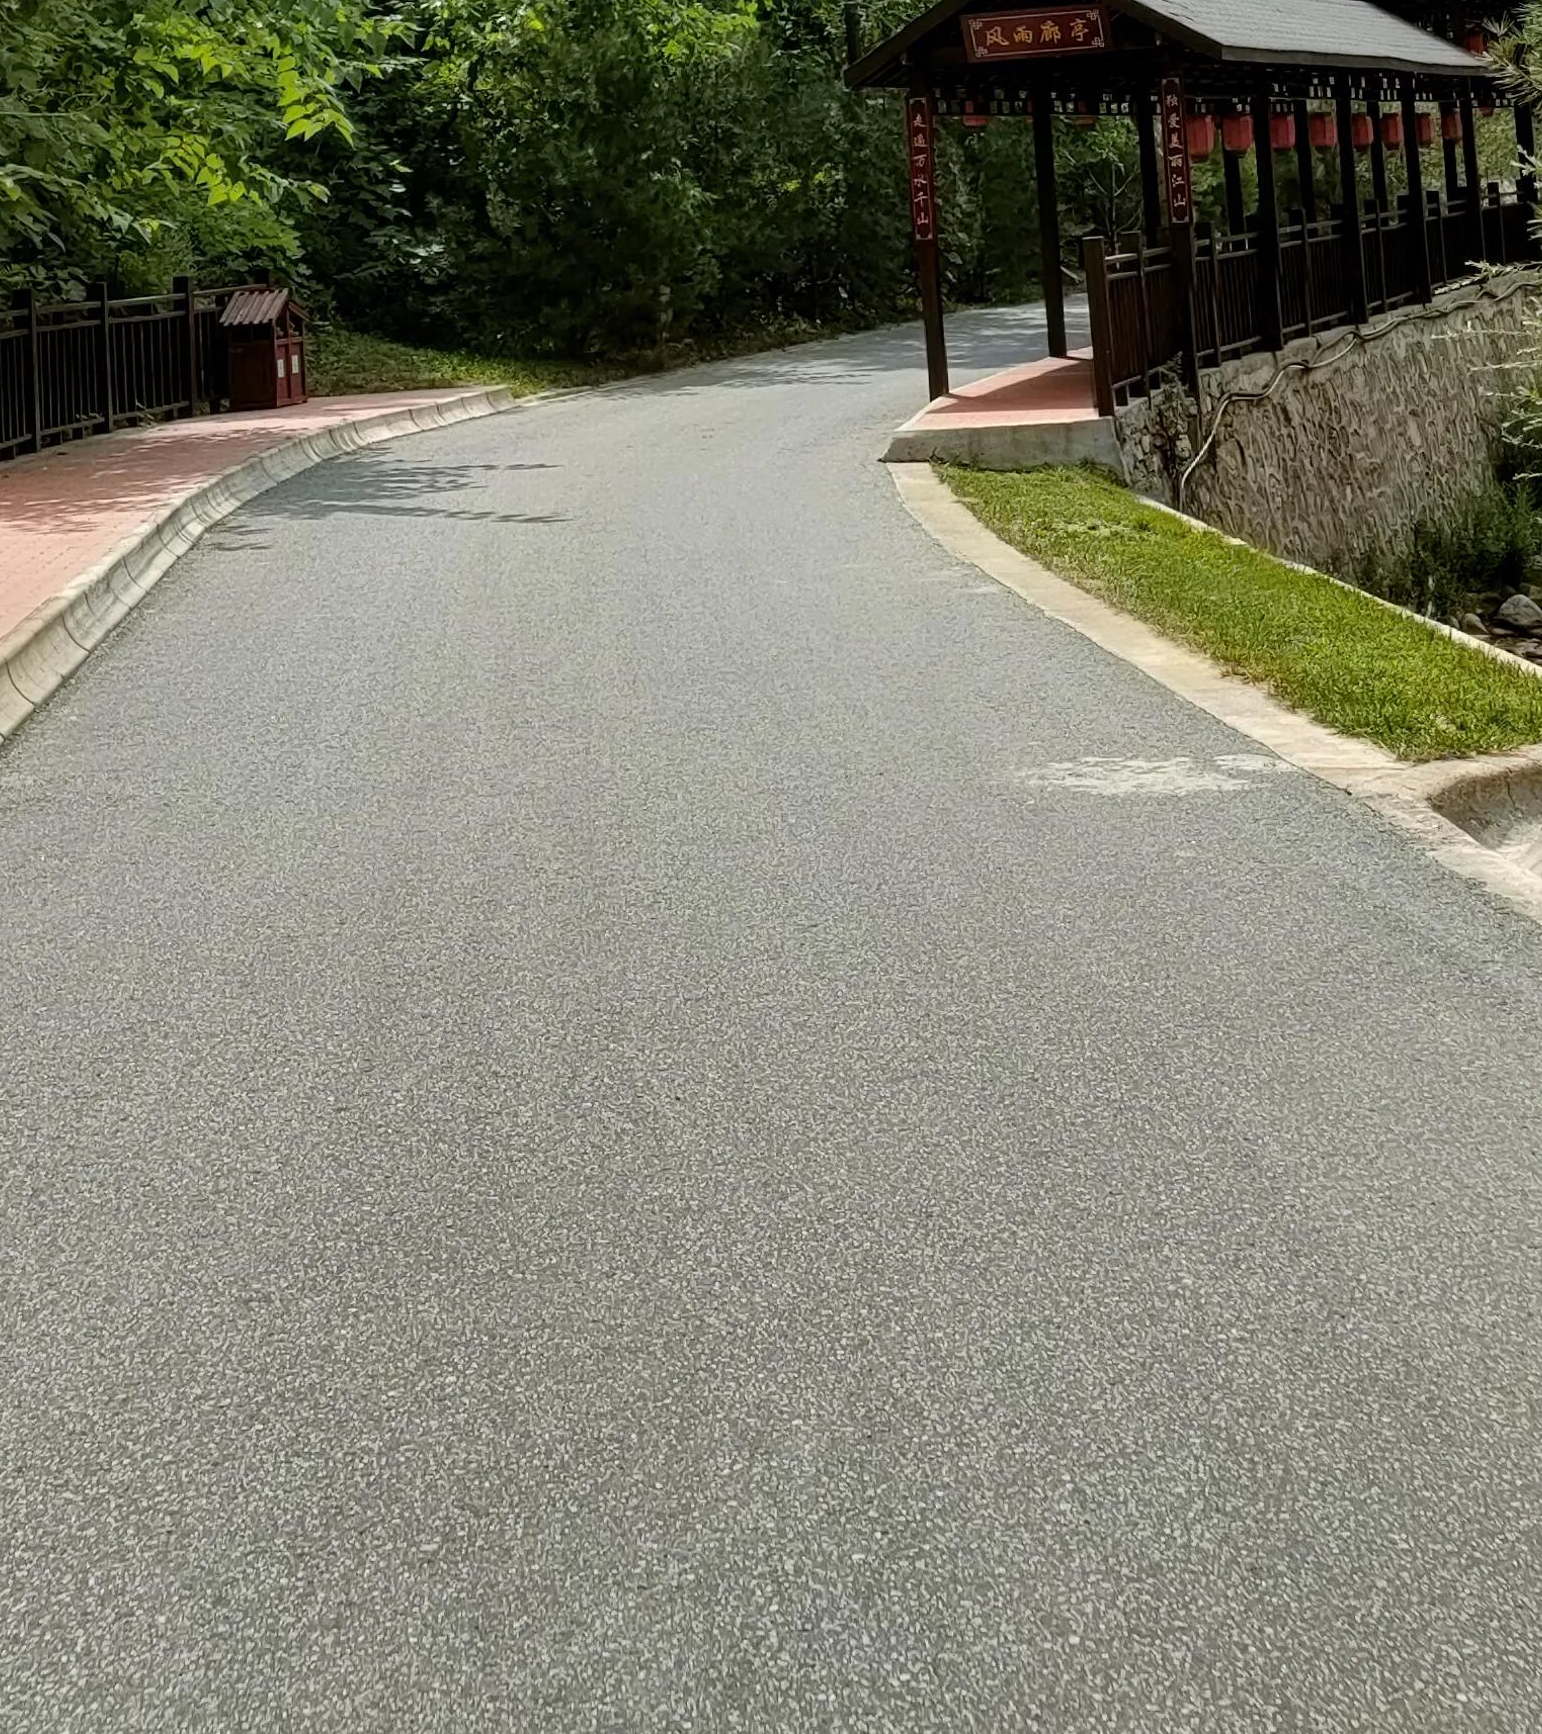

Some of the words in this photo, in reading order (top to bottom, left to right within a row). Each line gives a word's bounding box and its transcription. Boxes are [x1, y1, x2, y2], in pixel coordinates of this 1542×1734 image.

[986, 18, 1089, 46] 风雨廊亭
[1165, 94, 1186, 208] 独爱美丽江山
